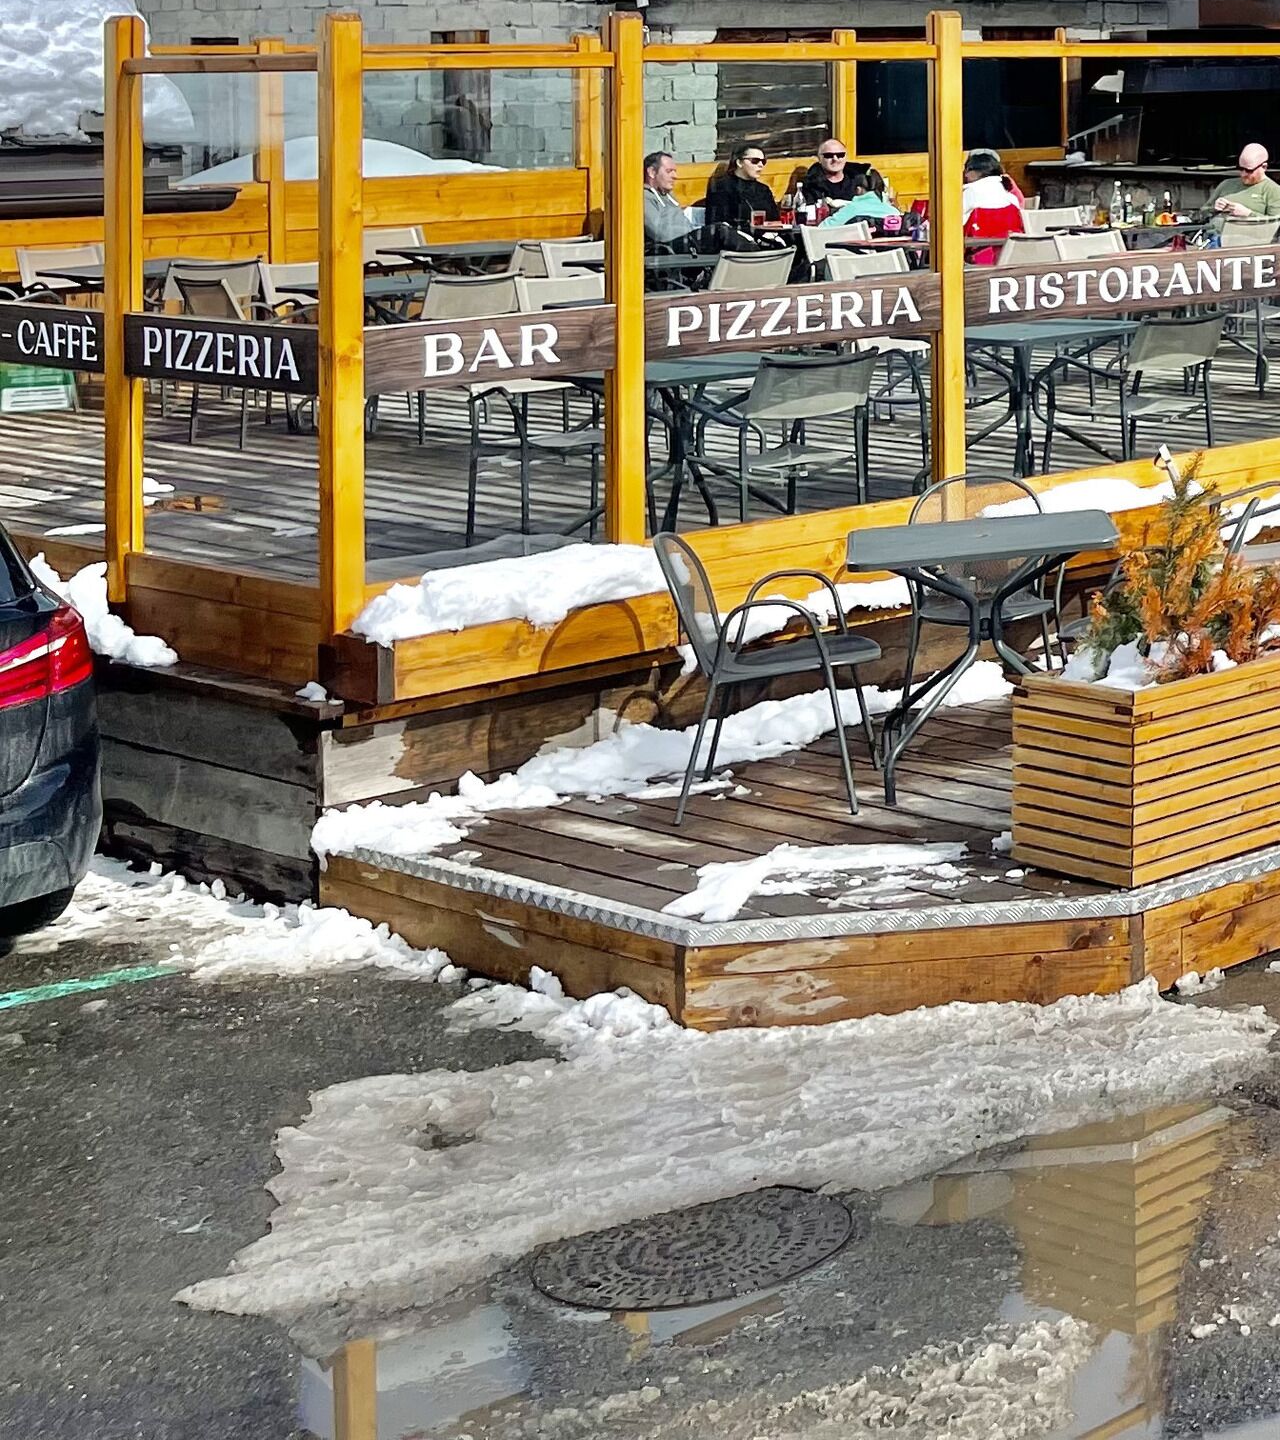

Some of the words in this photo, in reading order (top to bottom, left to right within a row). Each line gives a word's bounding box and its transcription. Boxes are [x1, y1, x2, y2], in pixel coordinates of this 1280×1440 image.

[988, 254, 1278, 314] RISTORANTE
[17, 314, 98, 362] CAFFÈ
[666, 287, 922, 347] PIZZERIA
[143, 326, 300, 382] PIZZERIA
[423, 323, 561, 378] BAR
